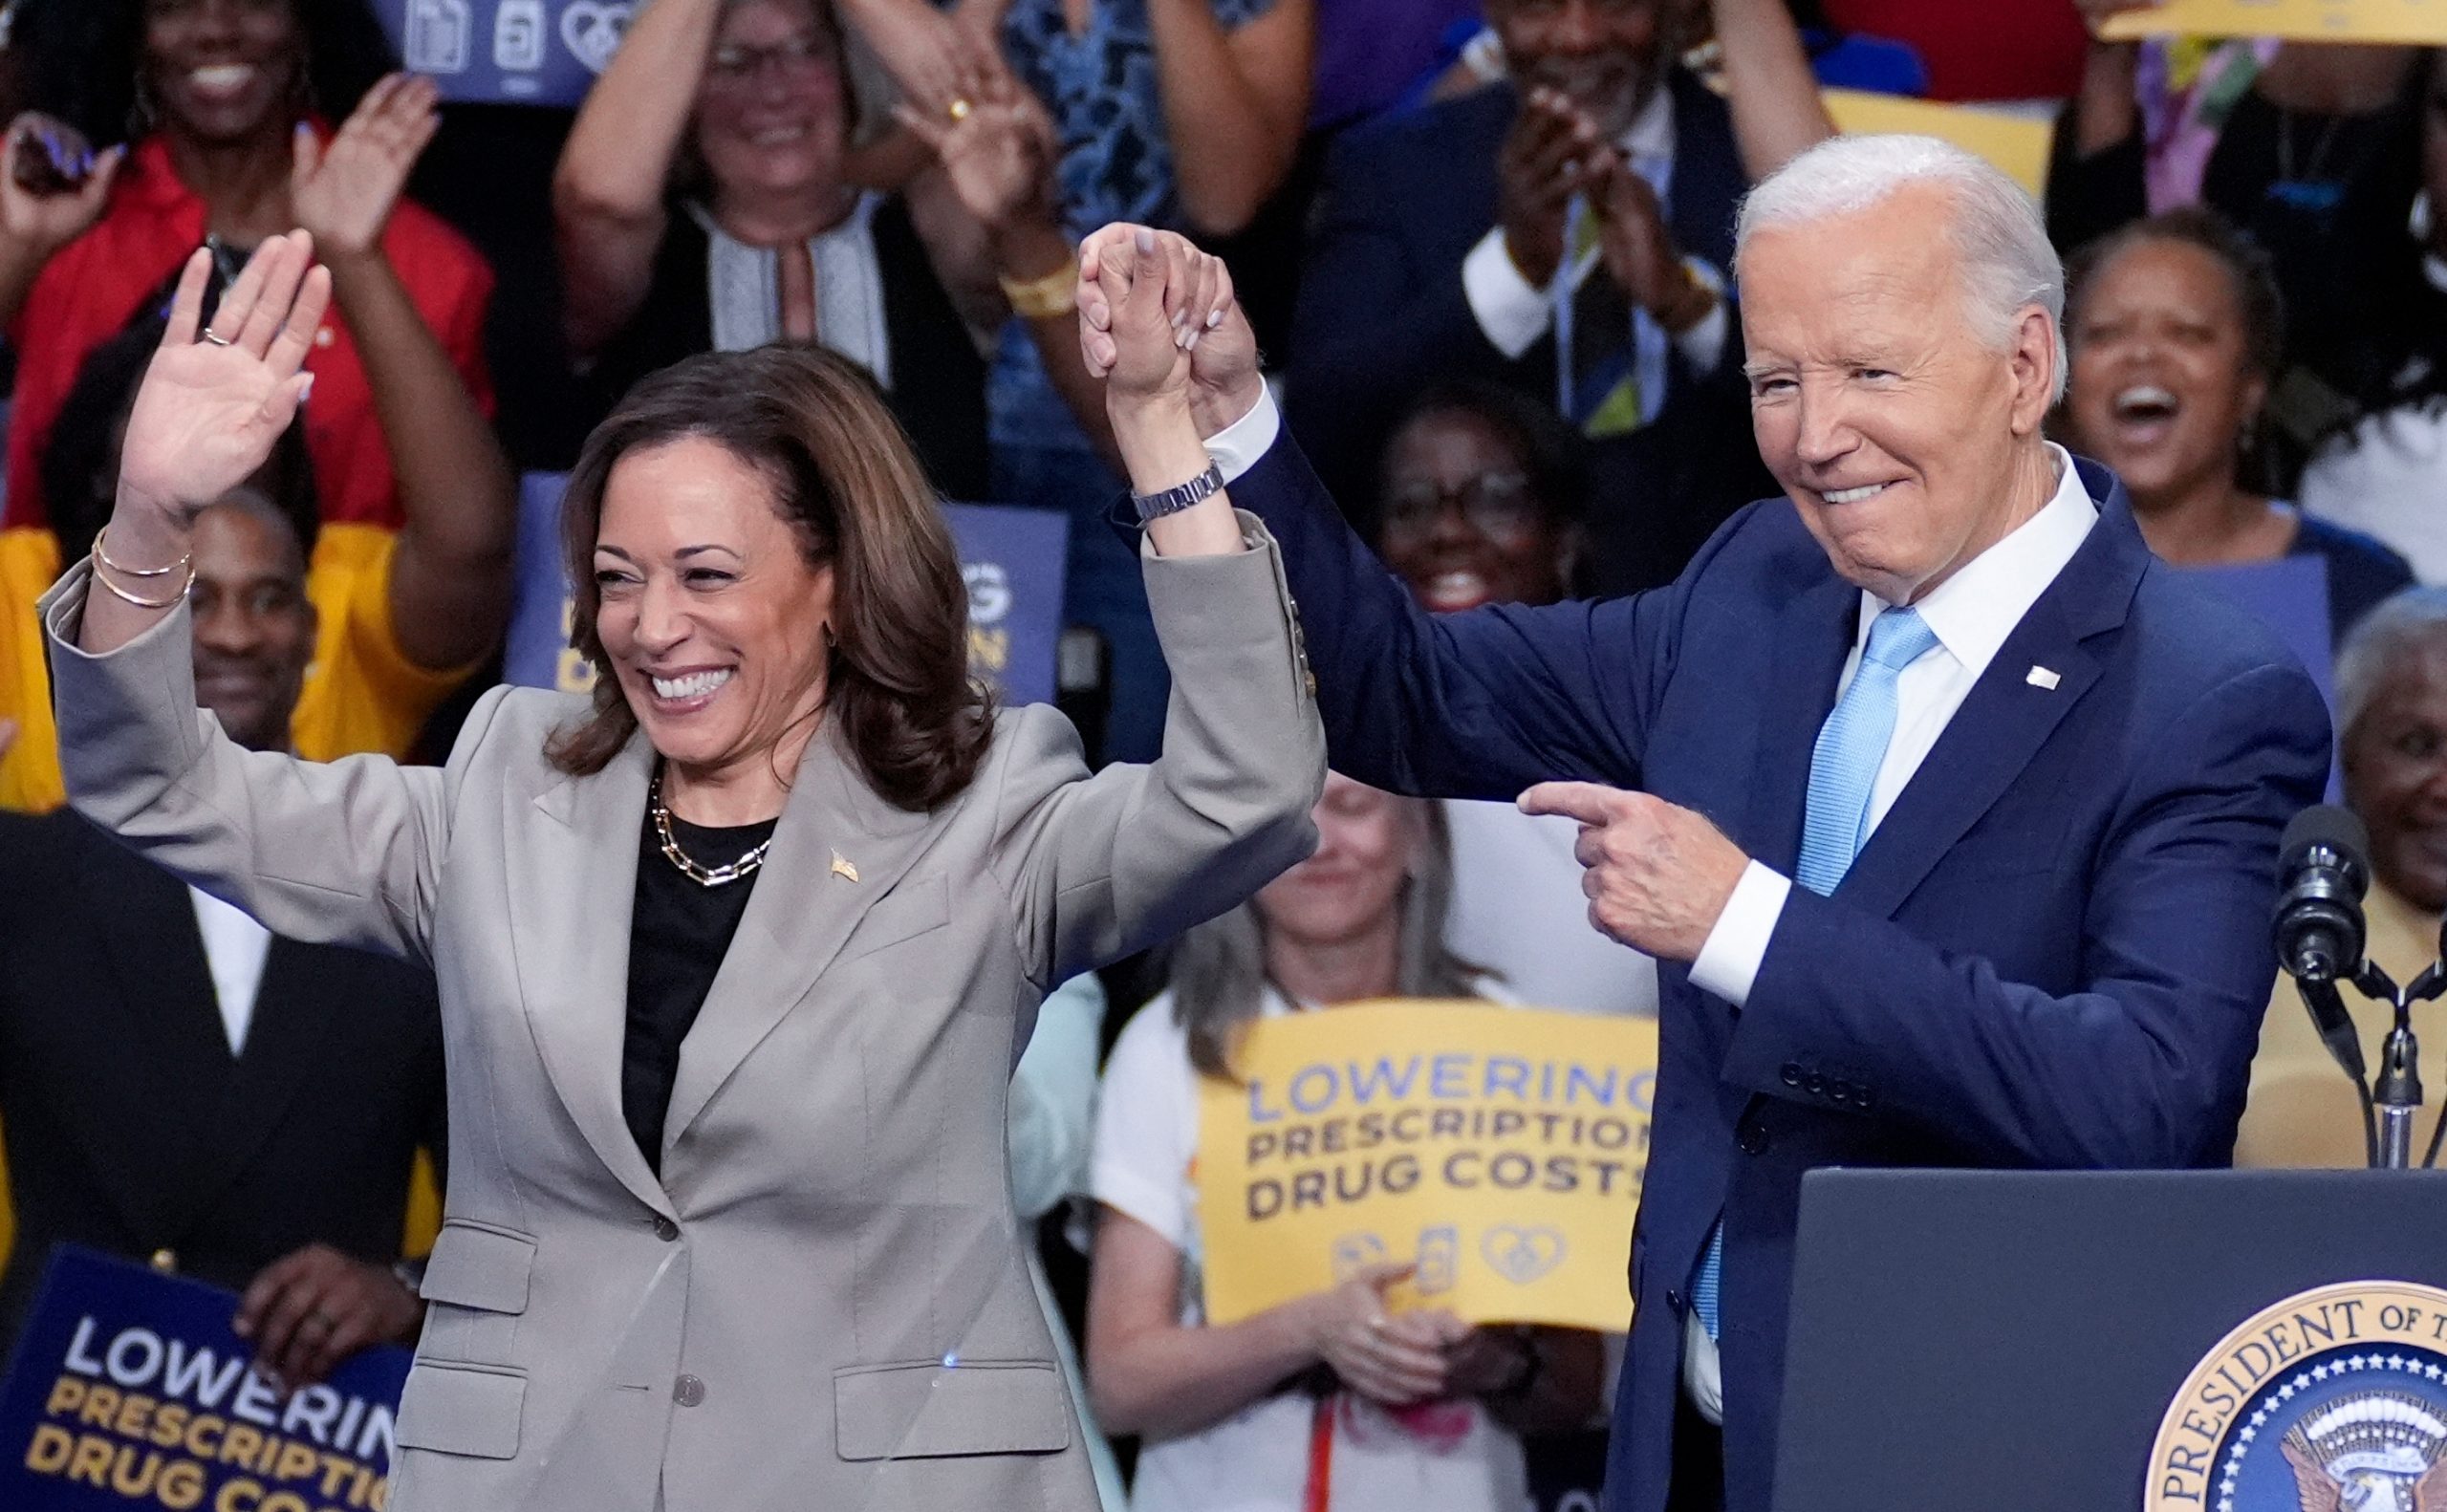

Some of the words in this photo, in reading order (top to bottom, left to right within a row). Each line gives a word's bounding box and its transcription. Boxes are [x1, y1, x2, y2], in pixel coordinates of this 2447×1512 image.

[1246, 1155, 1419, 1221] DRUG
[2163, 1300, 2363, 1503] PRESIDENT
[2380, 1306, 2421, 1331] OF
[26, 1423, 206, 1509] DRUG
